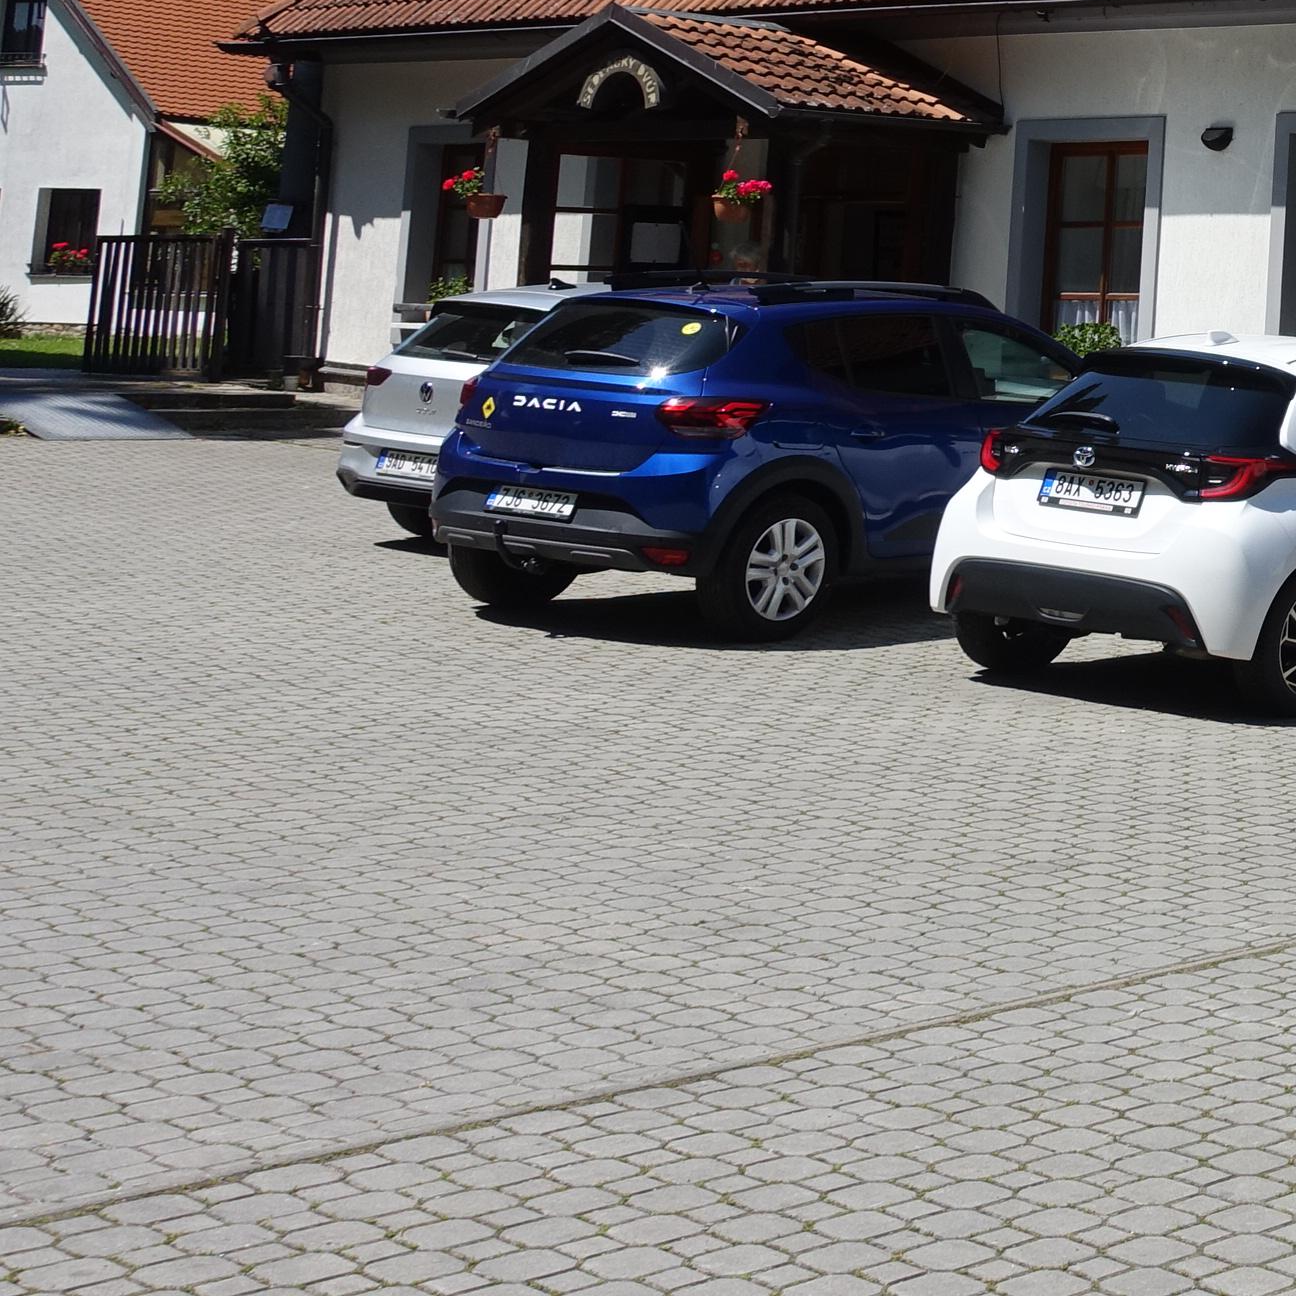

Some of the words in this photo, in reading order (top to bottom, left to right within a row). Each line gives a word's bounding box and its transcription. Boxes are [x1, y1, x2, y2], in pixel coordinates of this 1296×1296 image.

[513, 395, 582, 412] DACIA
[496, 487, 526, 507] 7J6
[531, 491, 571, 514] 3672
[1055, 475, 1085, 497] 8AX
[1094, 479, 1135, 503] 5363
